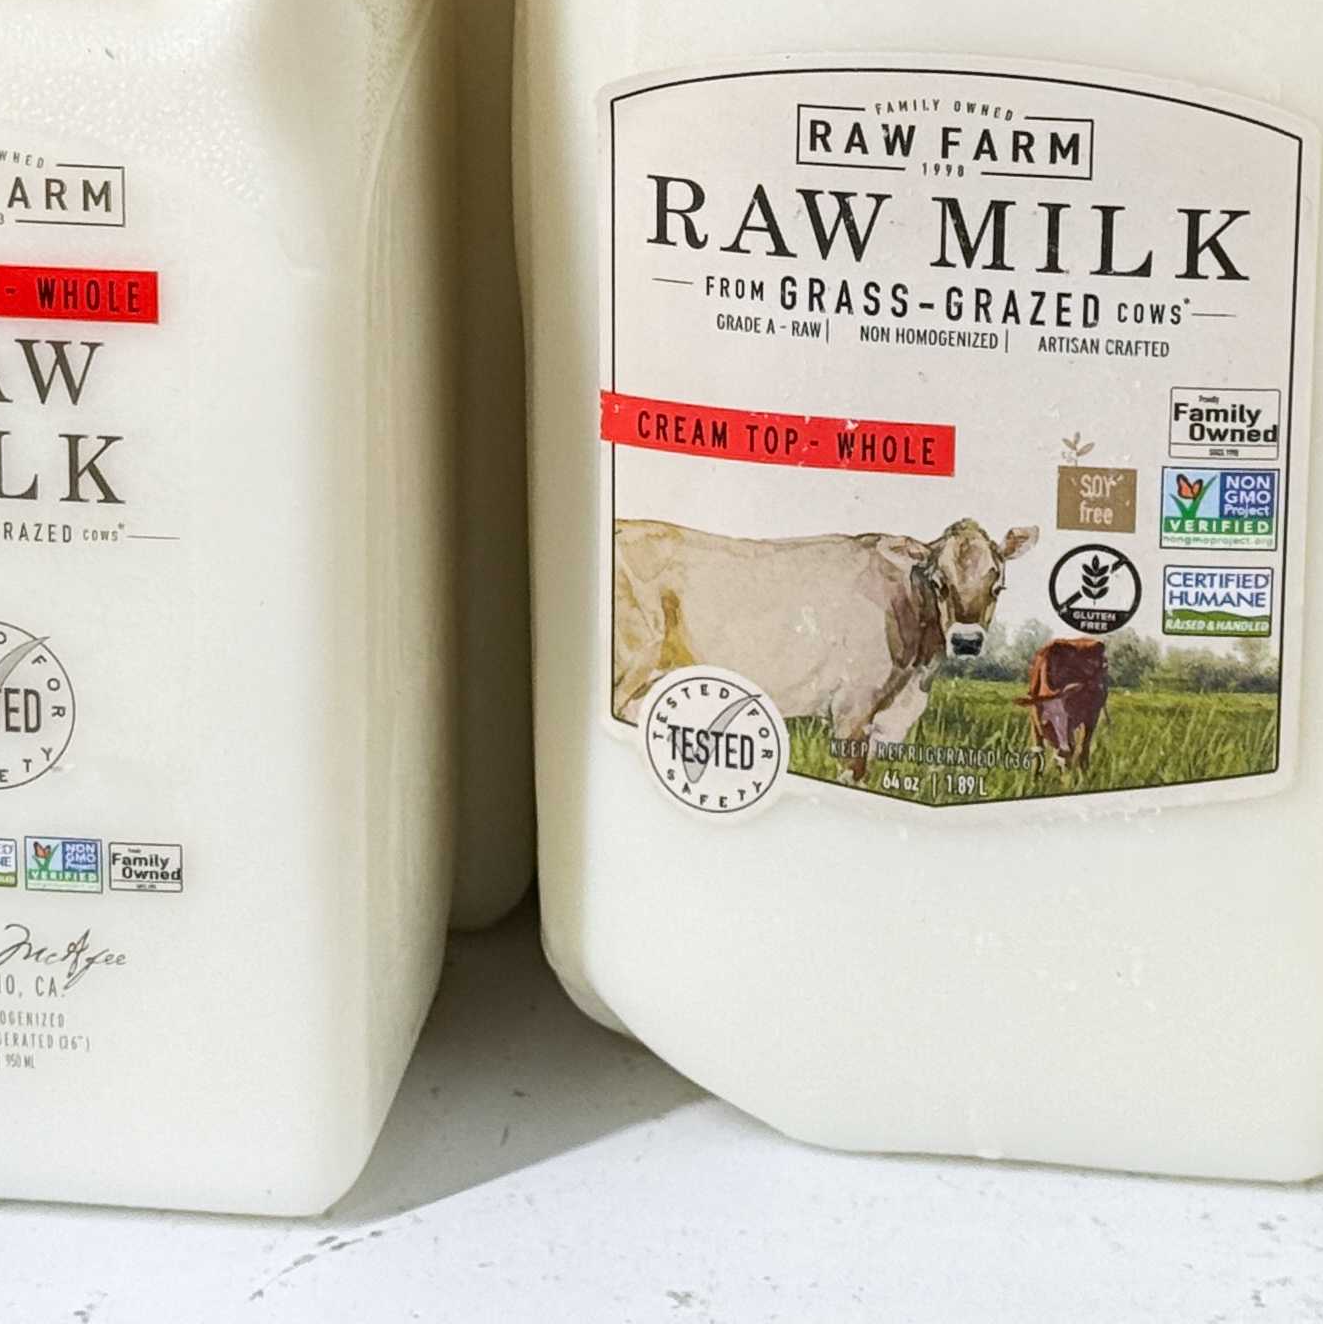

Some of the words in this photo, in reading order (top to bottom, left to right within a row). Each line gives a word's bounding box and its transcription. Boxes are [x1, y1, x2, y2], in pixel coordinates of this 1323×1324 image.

[875, 98, 940, 115] FAMILY
[954, 99, 1013, 122] OWNED
[809, 119, 916, 157] RAW
[941, 126, 1080, 166] FARM
[922, 162, 965, 177] 1998
[646, 174, 892, 263] RAW
[930, 195, 1251, 281] MILK
[36, 276, 141, 314] WHOLE
[706, 275, 764, 302] FROM
[779, 274, 1100, 327] GRASS-GRAZED
[716, 313, 761, 335] GRADE
[765, 317, 776, 335] A
[791, 319, 822, 338] RAW
[859, 325, 891, 343] NON
[895, 326, 999, 350] HOMOGENIZED
[1037, 335, 1100, 355] ARTISAN
[1105, 338, 1170, 358] CRAFTED
[1174, 402, 1262, 428] Family
[637, 408, 728, 450] CREAM
[746, 424, 799, 455] TOP
[836, 430, 937, 466] WHOLE
[1189, 422, 1278, 443] Owned
[1079, 473, 1114, 499] SOY
[1225, 474, 1271, 491] NON
[1224, 488, 1271, 505] GMO
[1079, 502, 1115, 525] free
[1223, 502, 1271, 518] Project
[1170, 518, 1271, 534] VERIFIED
[1166, 571, 1271, 590] CERTIFIED
[1168, 589, 1267, 608] HUMANE
[1072, 610, 1117, 623] GLUTEN
[31, 654, 66, 718] FOR
[652, 683, 731, 742] TESTED
[746, 706, 774, 761] FOR
[668, 723, 755, 772] TESTED
[830, 739, 869, 758] KEEP
[877, 739, 997, 767] REFRIGERATED
[666, 767, 764, 809] SAFETY
[882, 771, 900, 790] 64
[904, 777, 920, 792] oz
[946, 774, 976, 795] 1.89
[979, 777, 988, 797] L
[65, 843, 96, 854] NON
[111, 852, 172, 871] Family
[122, 865, 182, 882] Owned
